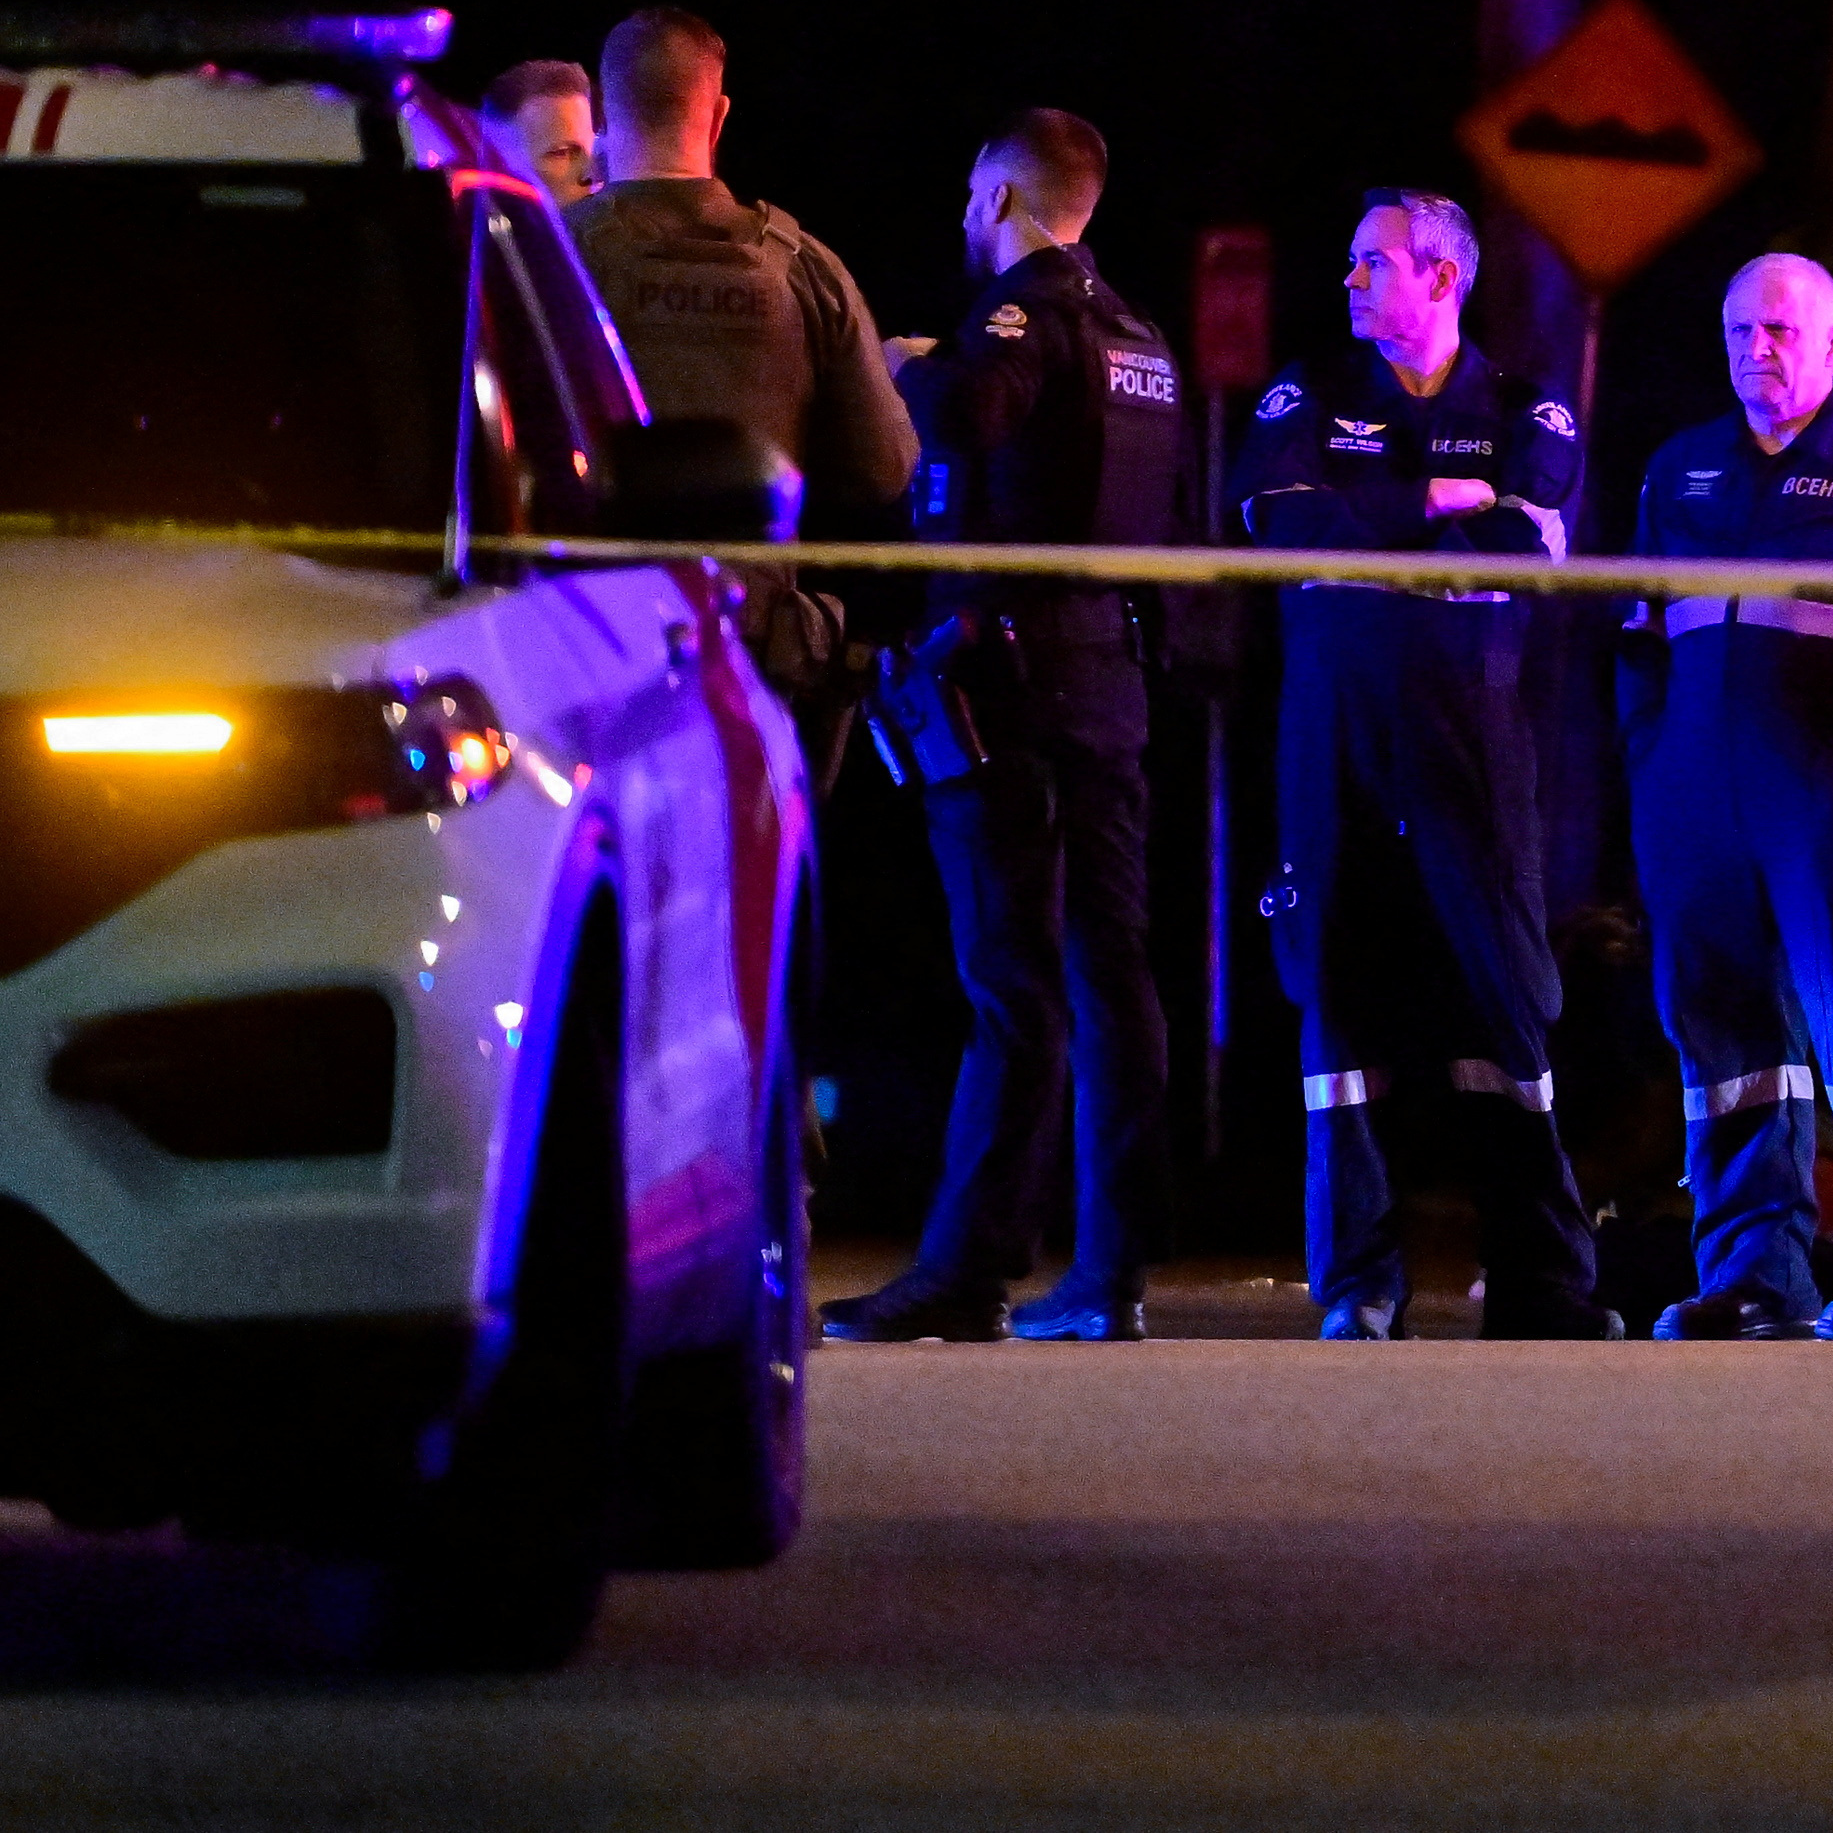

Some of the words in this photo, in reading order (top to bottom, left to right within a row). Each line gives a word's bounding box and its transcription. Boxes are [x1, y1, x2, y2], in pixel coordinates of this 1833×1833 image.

[637, 281, 769, 317] POLICE
[1109, 366, 1175, 403] POLICE
[1431, 439, 1493, 456] BCEHS
